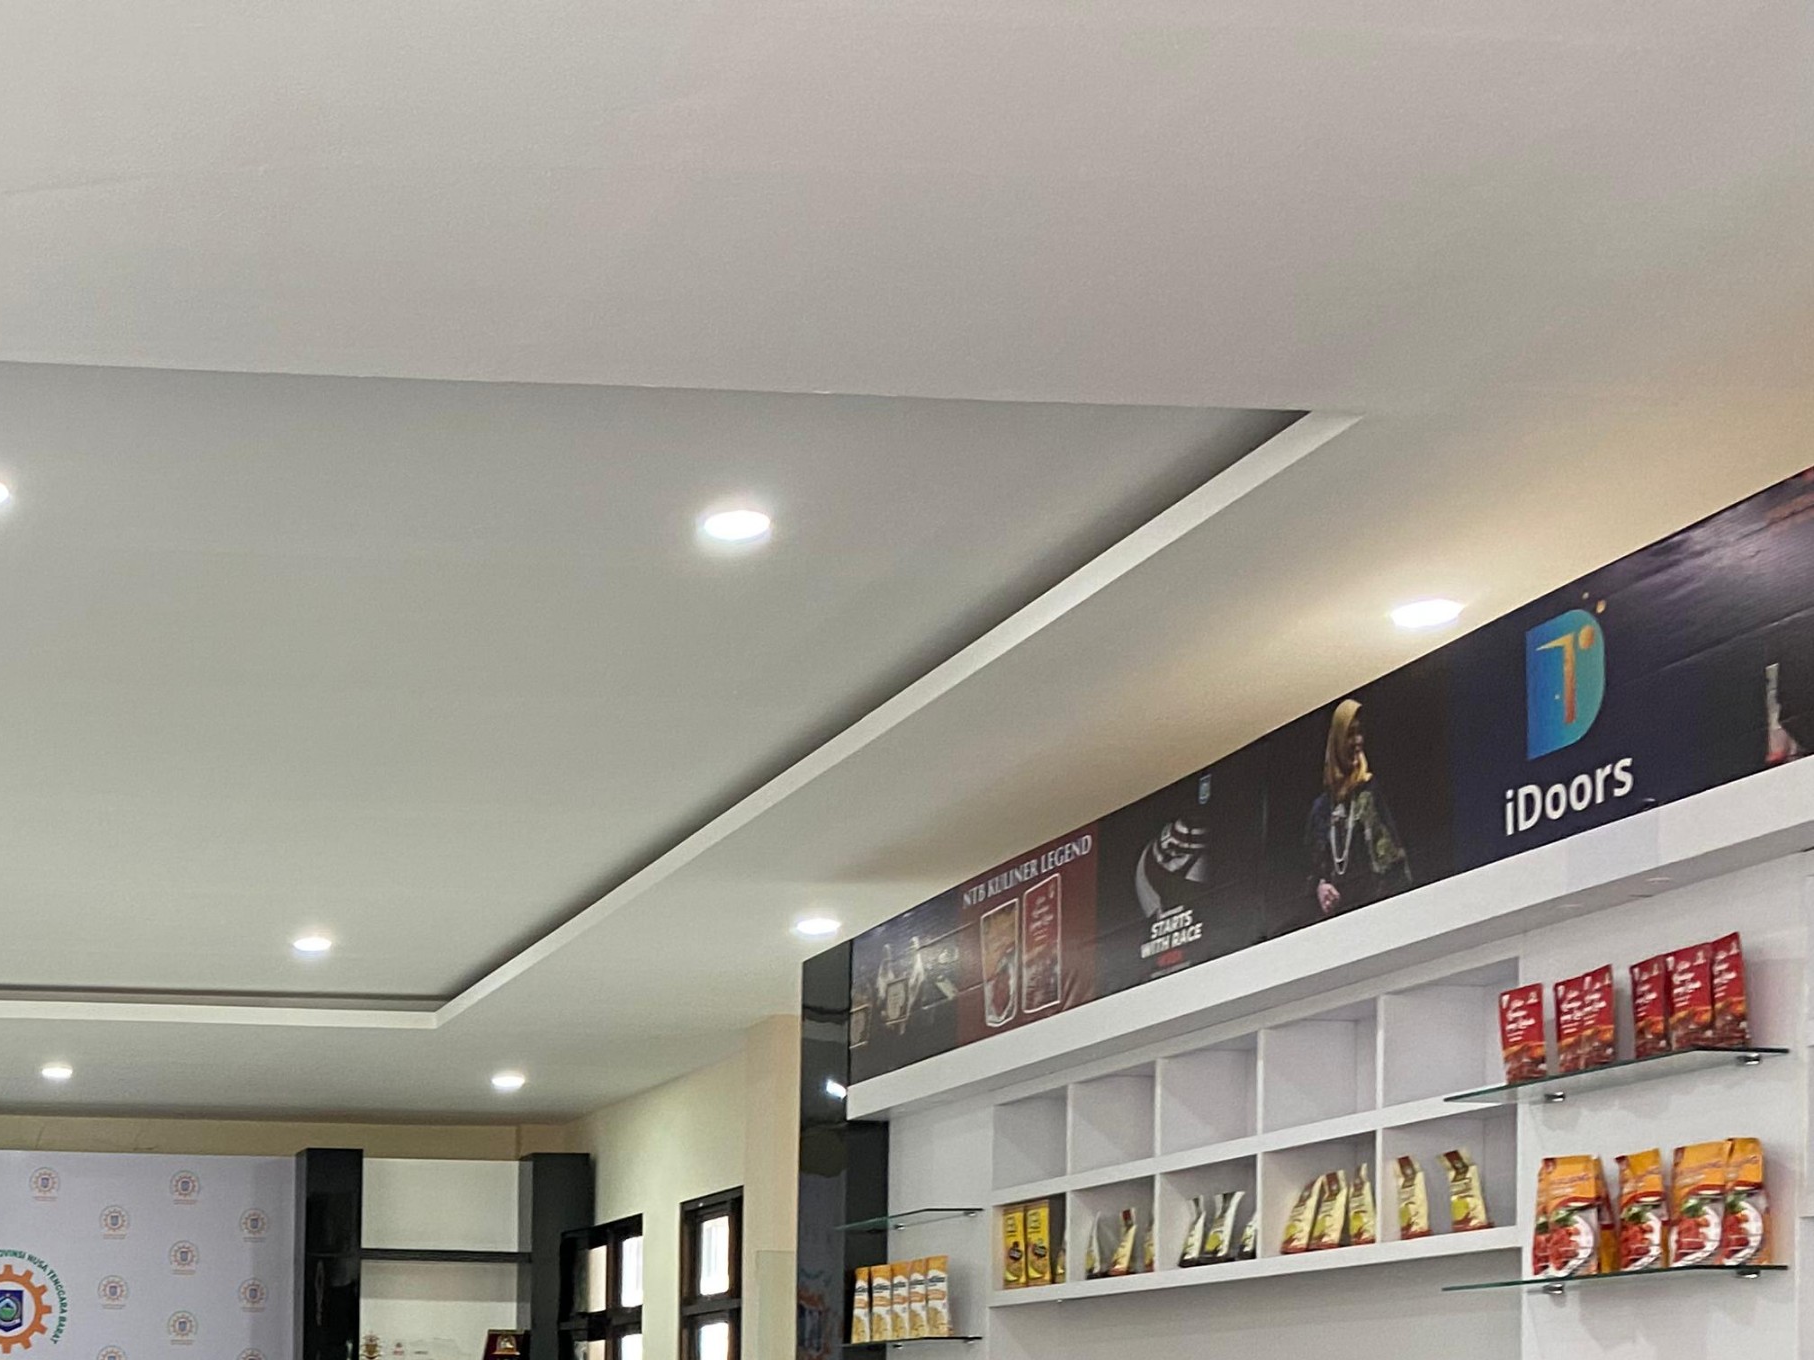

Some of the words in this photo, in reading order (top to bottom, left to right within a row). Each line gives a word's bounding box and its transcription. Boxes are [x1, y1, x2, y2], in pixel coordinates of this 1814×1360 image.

[1503, 756, 1635, 836] iDoors
[987, 859, 1039, 898] KULINER
[1040, 834, 1094, 873] LEGEND
[1150, 910, 1193, 939] STARTS
[1170, 922, 1203, 948] RACE
